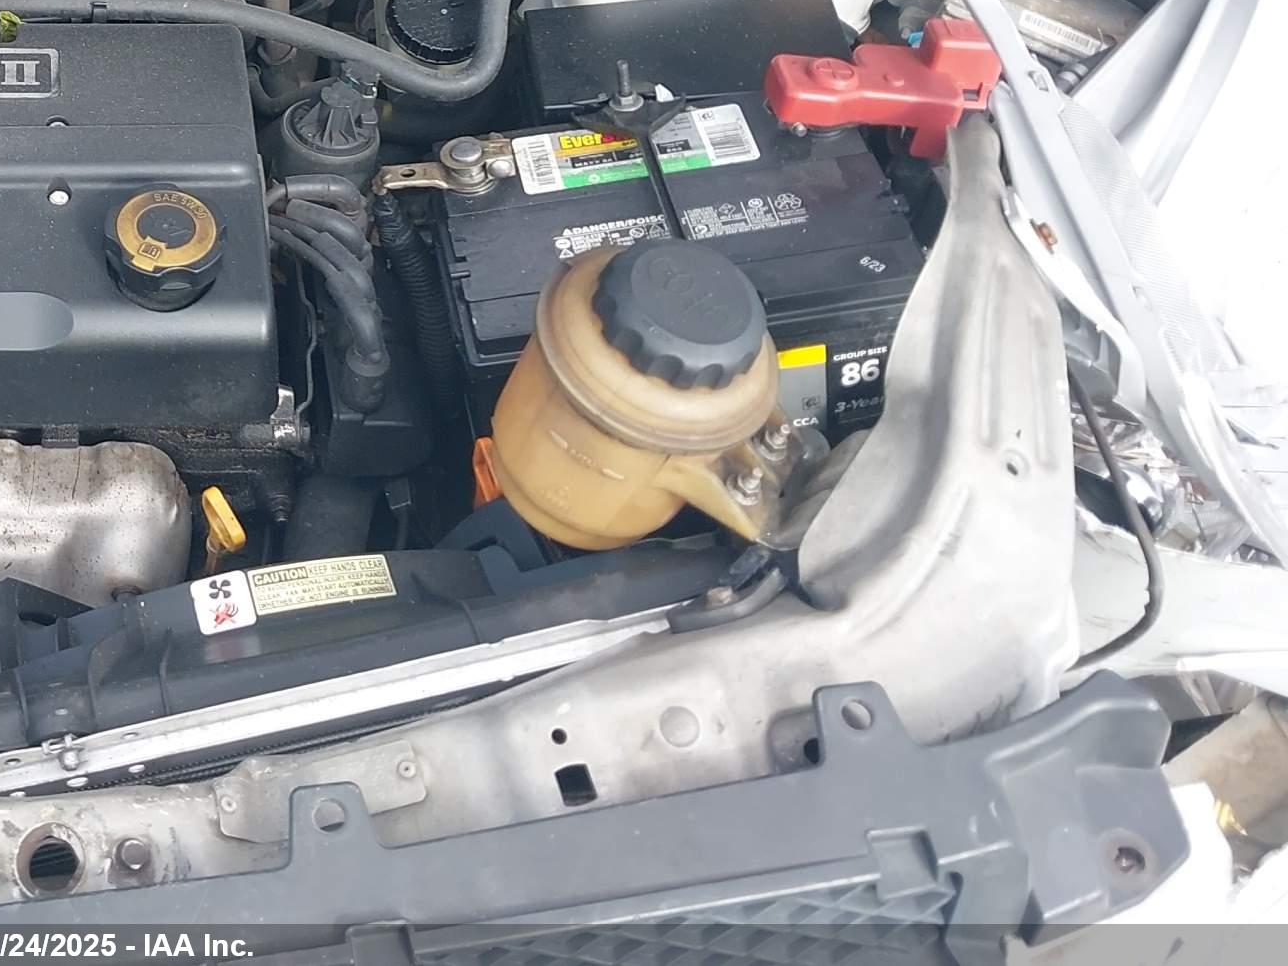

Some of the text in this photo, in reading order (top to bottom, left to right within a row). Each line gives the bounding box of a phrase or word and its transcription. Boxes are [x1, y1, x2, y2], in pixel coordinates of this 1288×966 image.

[153, 193, 179, 202] SAE
[860, 256, 886, 273] 6/23
[833, 345, 888, 362] GROUP SIZE
[841, 358, 880, 386] 86
[793, 416, 819, 427] CCA
[254, 558, 385, 586] CAUTION KEEP HANDS CLEAR
[287, 578, 322, 589] PERSONAL
[323, 575, 346, 583] INJURY
[348, 573, 364, 581] KEEP
[365, 570, 387, 579] HANDS
[302, 586, 315, 594] MAY
[316, 583, 337, 592] START
[338, 578, 389, 589] AUTOMATICALLY
[296, 595, 306, 603] OR
[309, 592, 322, 601] NOT
[325, 589, 350, 599] ENGINE
